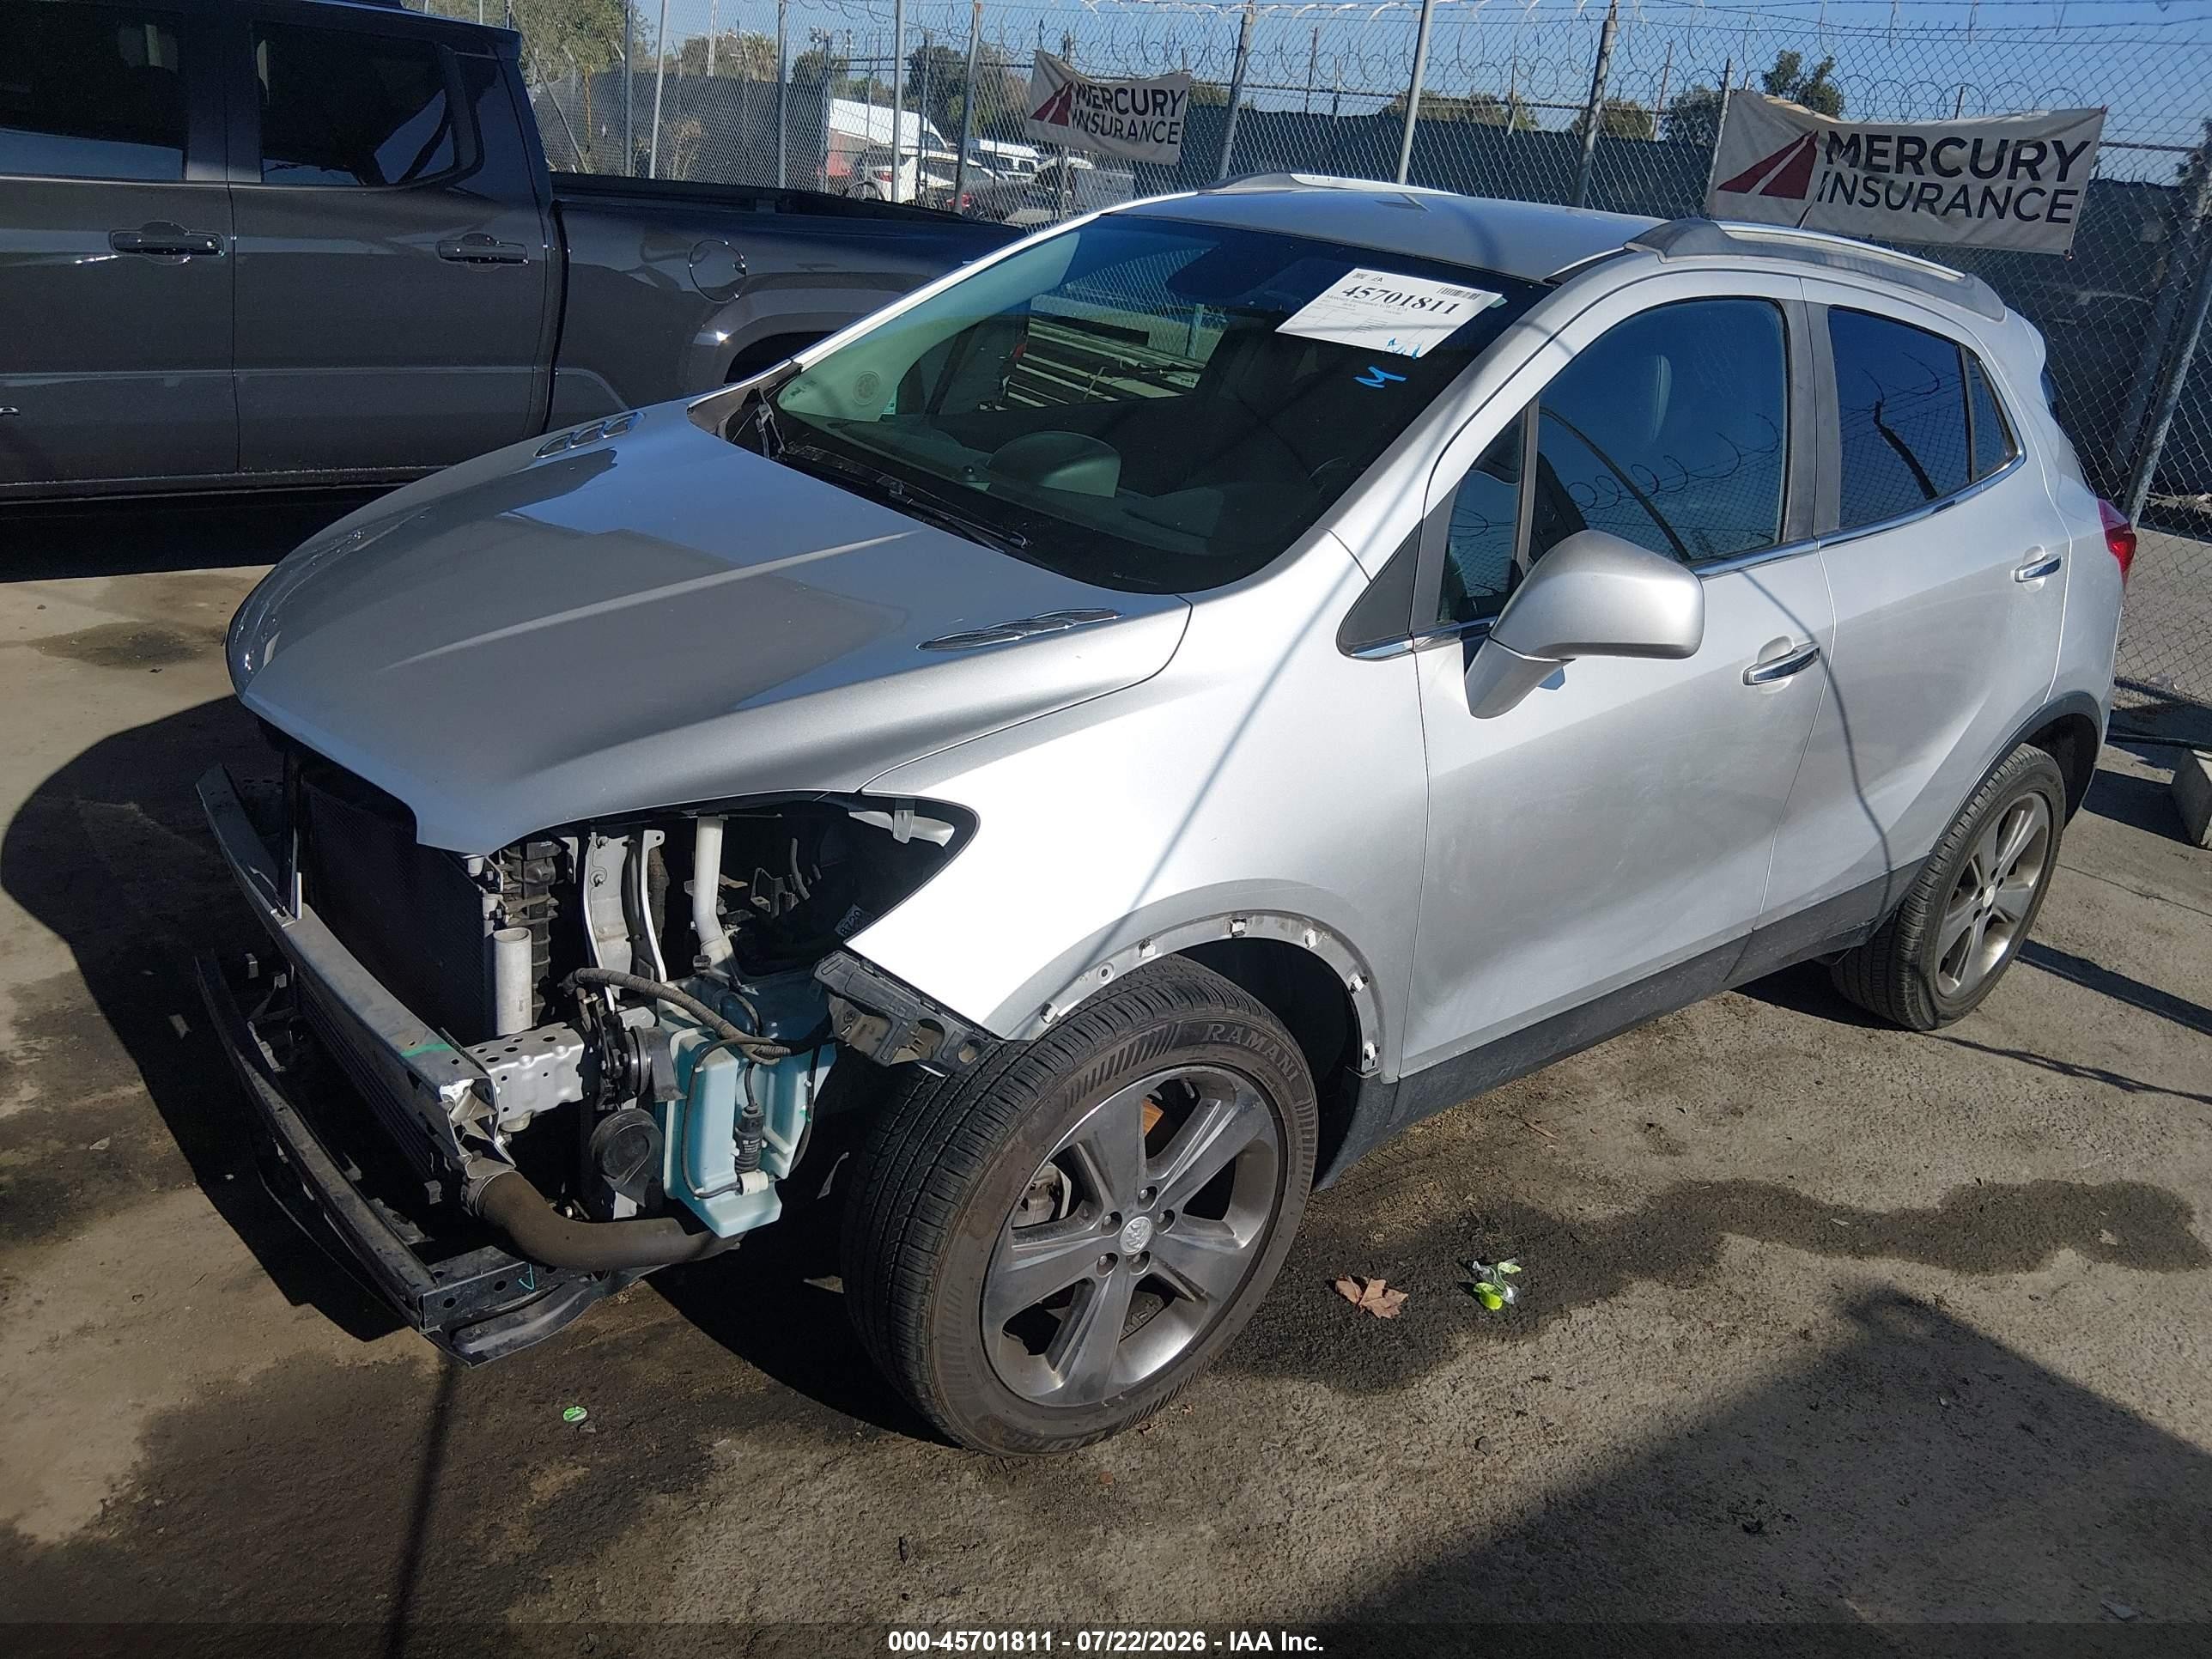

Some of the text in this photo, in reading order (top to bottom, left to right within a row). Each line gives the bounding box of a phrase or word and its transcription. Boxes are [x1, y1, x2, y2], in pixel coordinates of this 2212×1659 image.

[1075, 82, 1186, 118] MERCURY
[1072, 108, 1181, 145] INSURANCE
[1826, 131, 2091, 183] MERCURY
[1817, 171, 2079, 224] INSURANCE
[1341, 285, 1461, 315] 45701811
